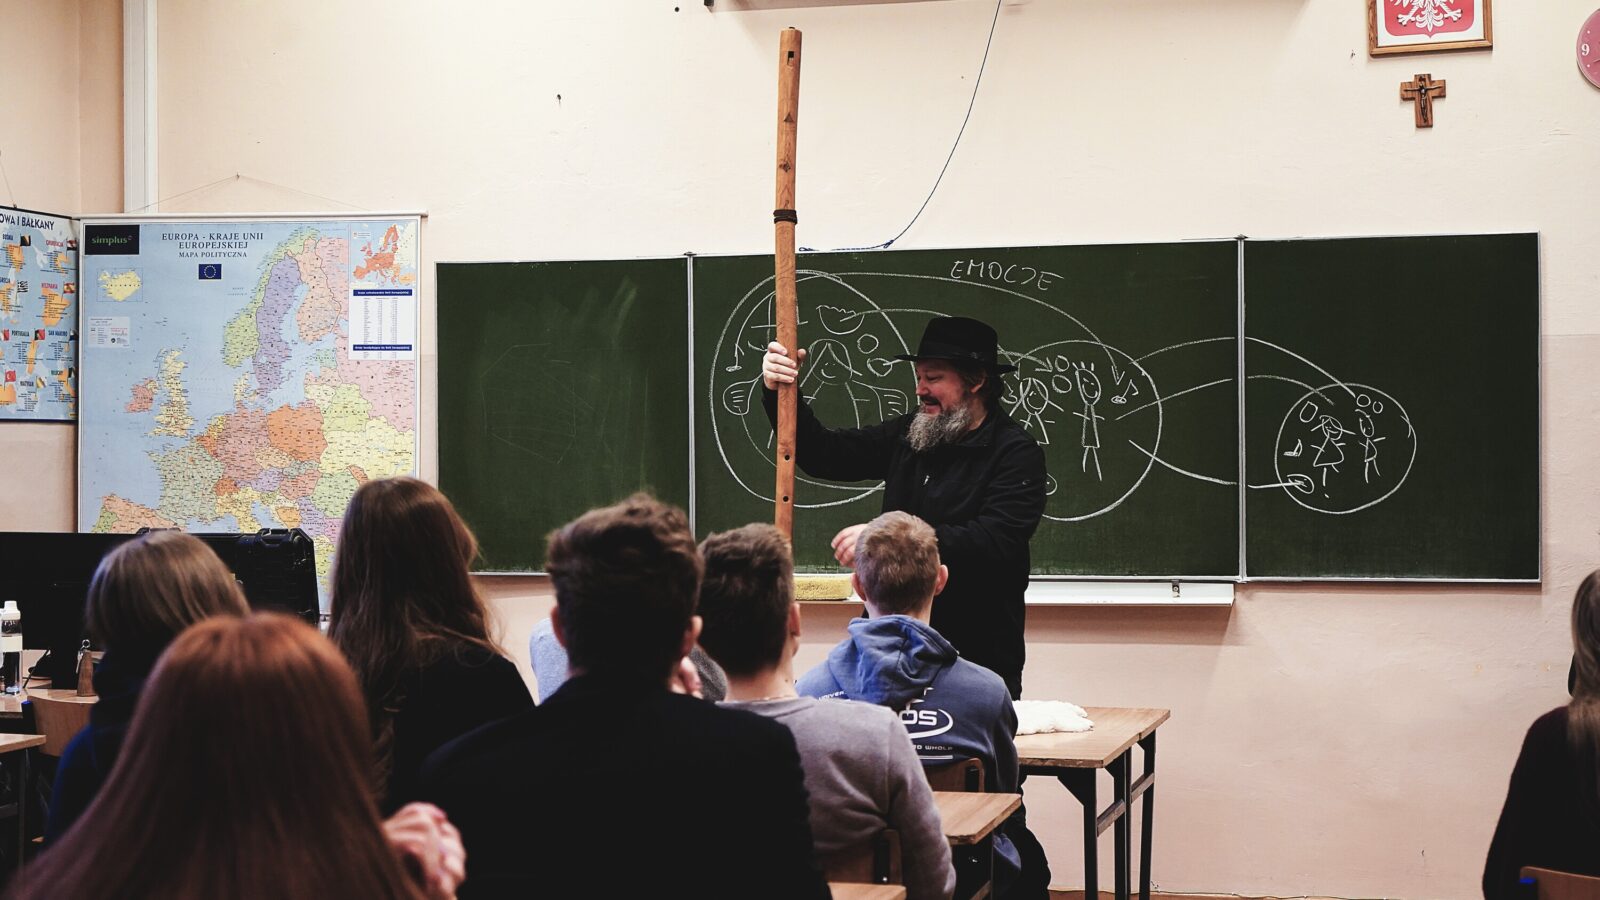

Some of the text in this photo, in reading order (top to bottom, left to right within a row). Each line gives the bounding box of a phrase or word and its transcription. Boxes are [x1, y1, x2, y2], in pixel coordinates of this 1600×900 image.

[1581, 43, 1590, 56] 9
[17, 216, 20, 225] I
[22, 217, 55, 230] BAŁKANY
[91, 235, 128, 246] simplus
[162, 233, 199, 241] EUROPA
[209, 233, 240, 241] KRAJE
[243, 232, 264, 240] UNII
[179, 241, 248, 249] EUROPEJSKIEJ
